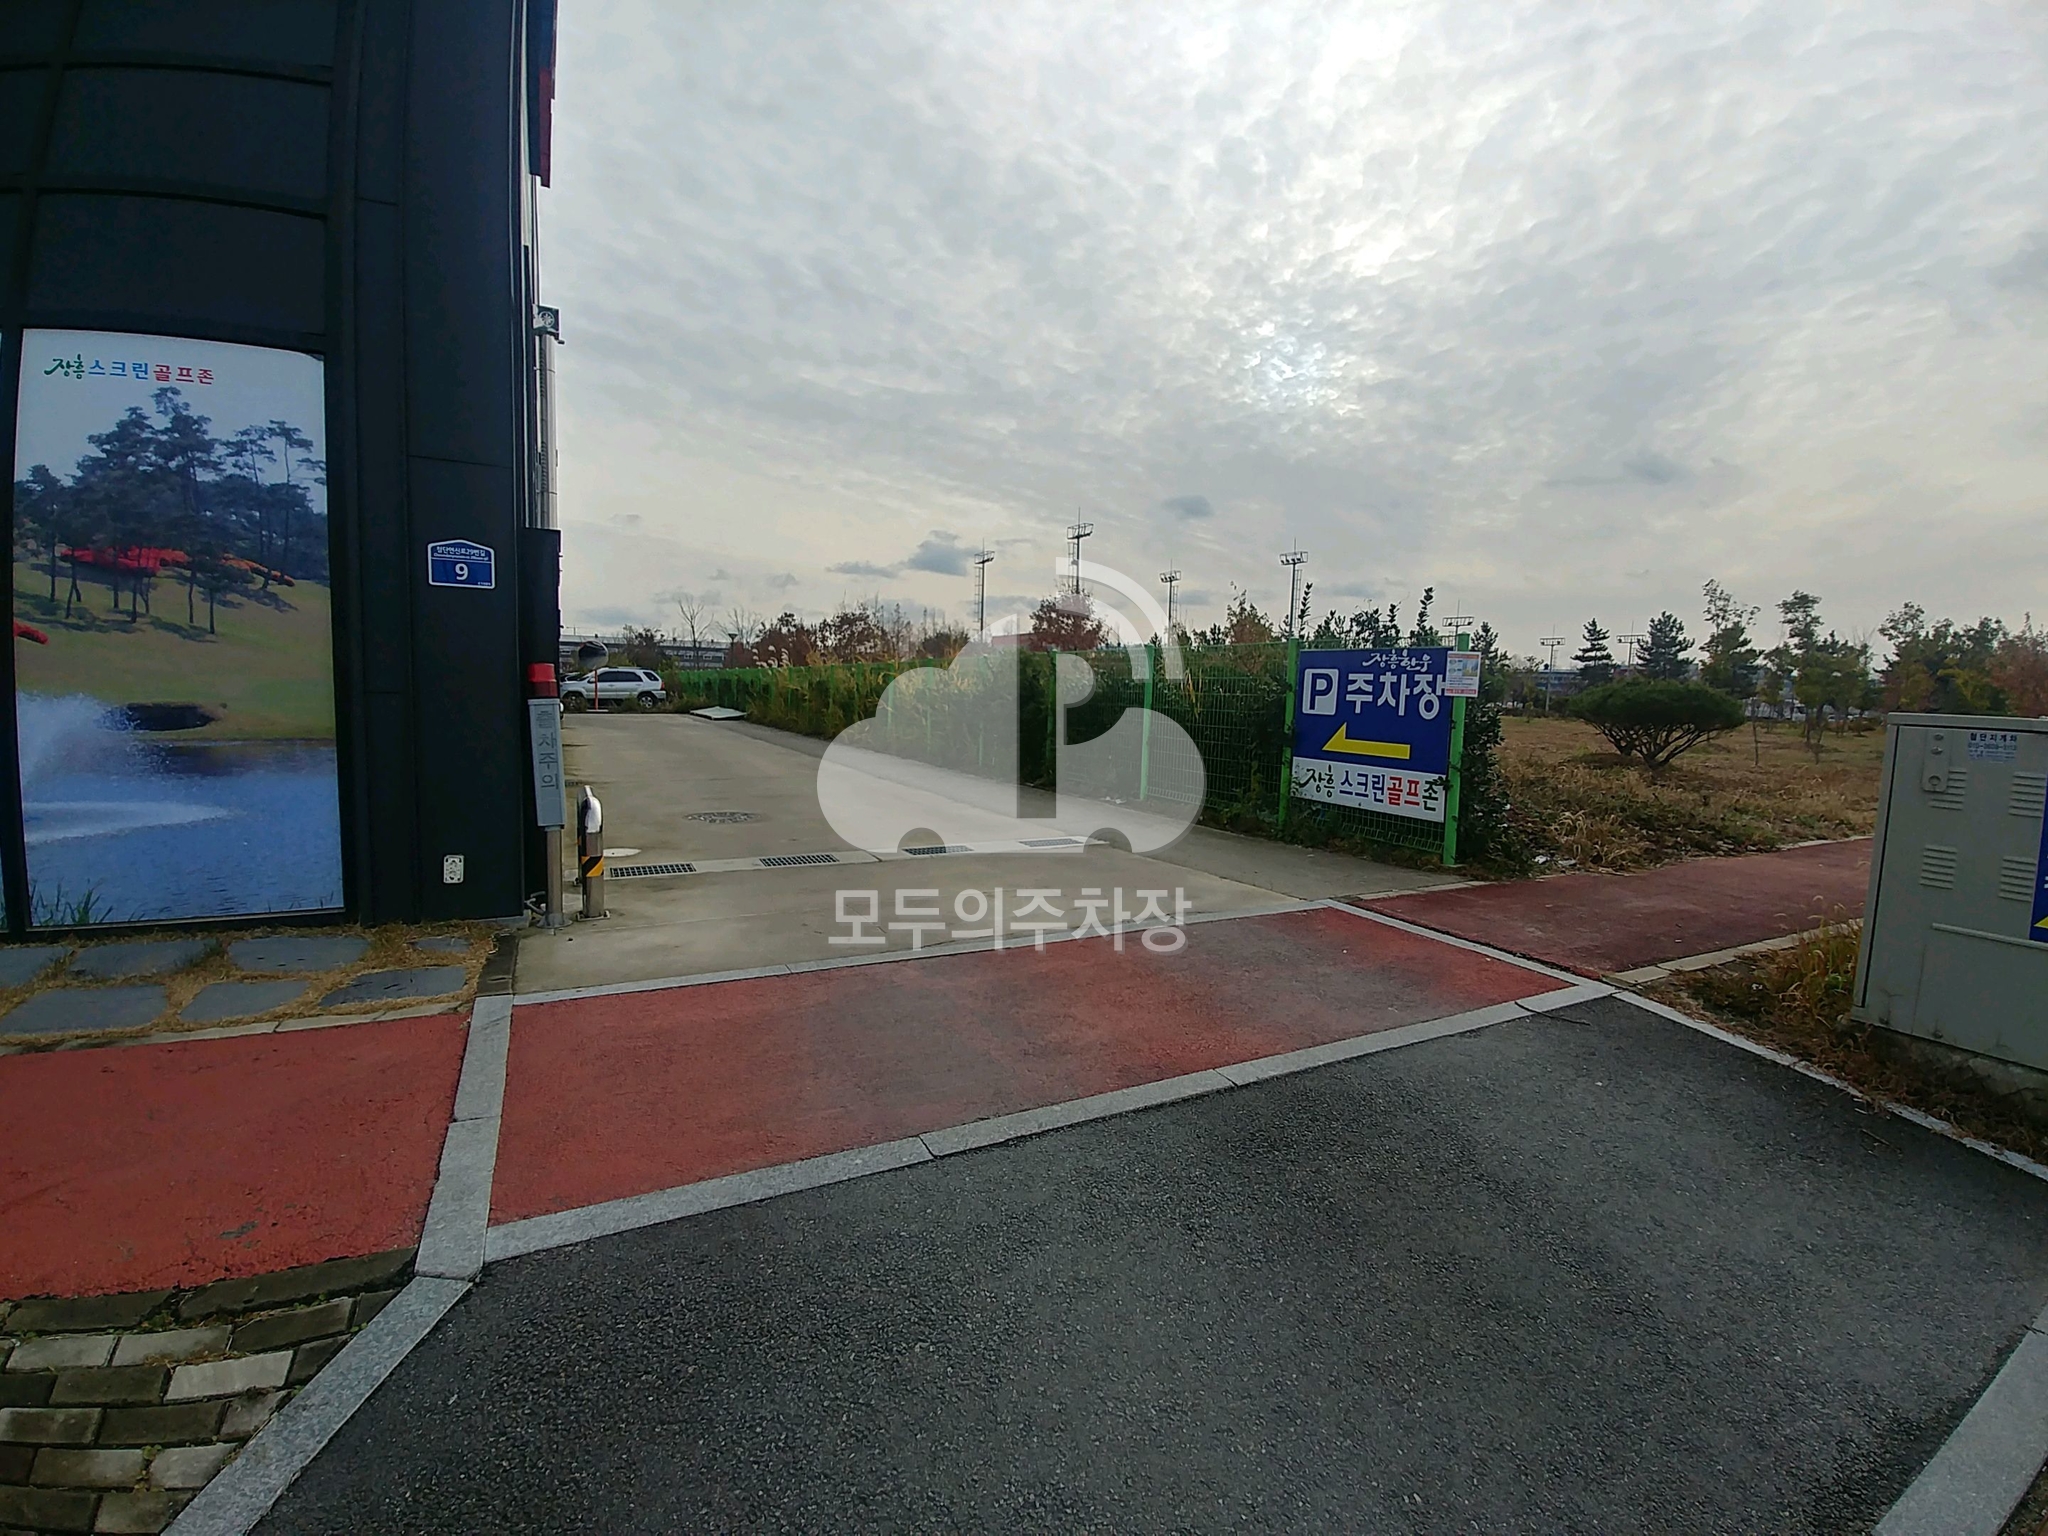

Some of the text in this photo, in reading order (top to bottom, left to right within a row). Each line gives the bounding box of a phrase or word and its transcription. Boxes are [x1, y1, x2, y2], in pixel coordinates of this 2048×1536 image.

[44, 354, 214, 385] 장흥 스크린골프존
[455, 563, 468, 581] 9
[1307, 671, 1334, 711] P
[1345, 672, 1447, 720] 주차장
[536, 710, 559, 790] 출차주의
[1300, 764, 1441, 812] 장흥 스크린골프존
